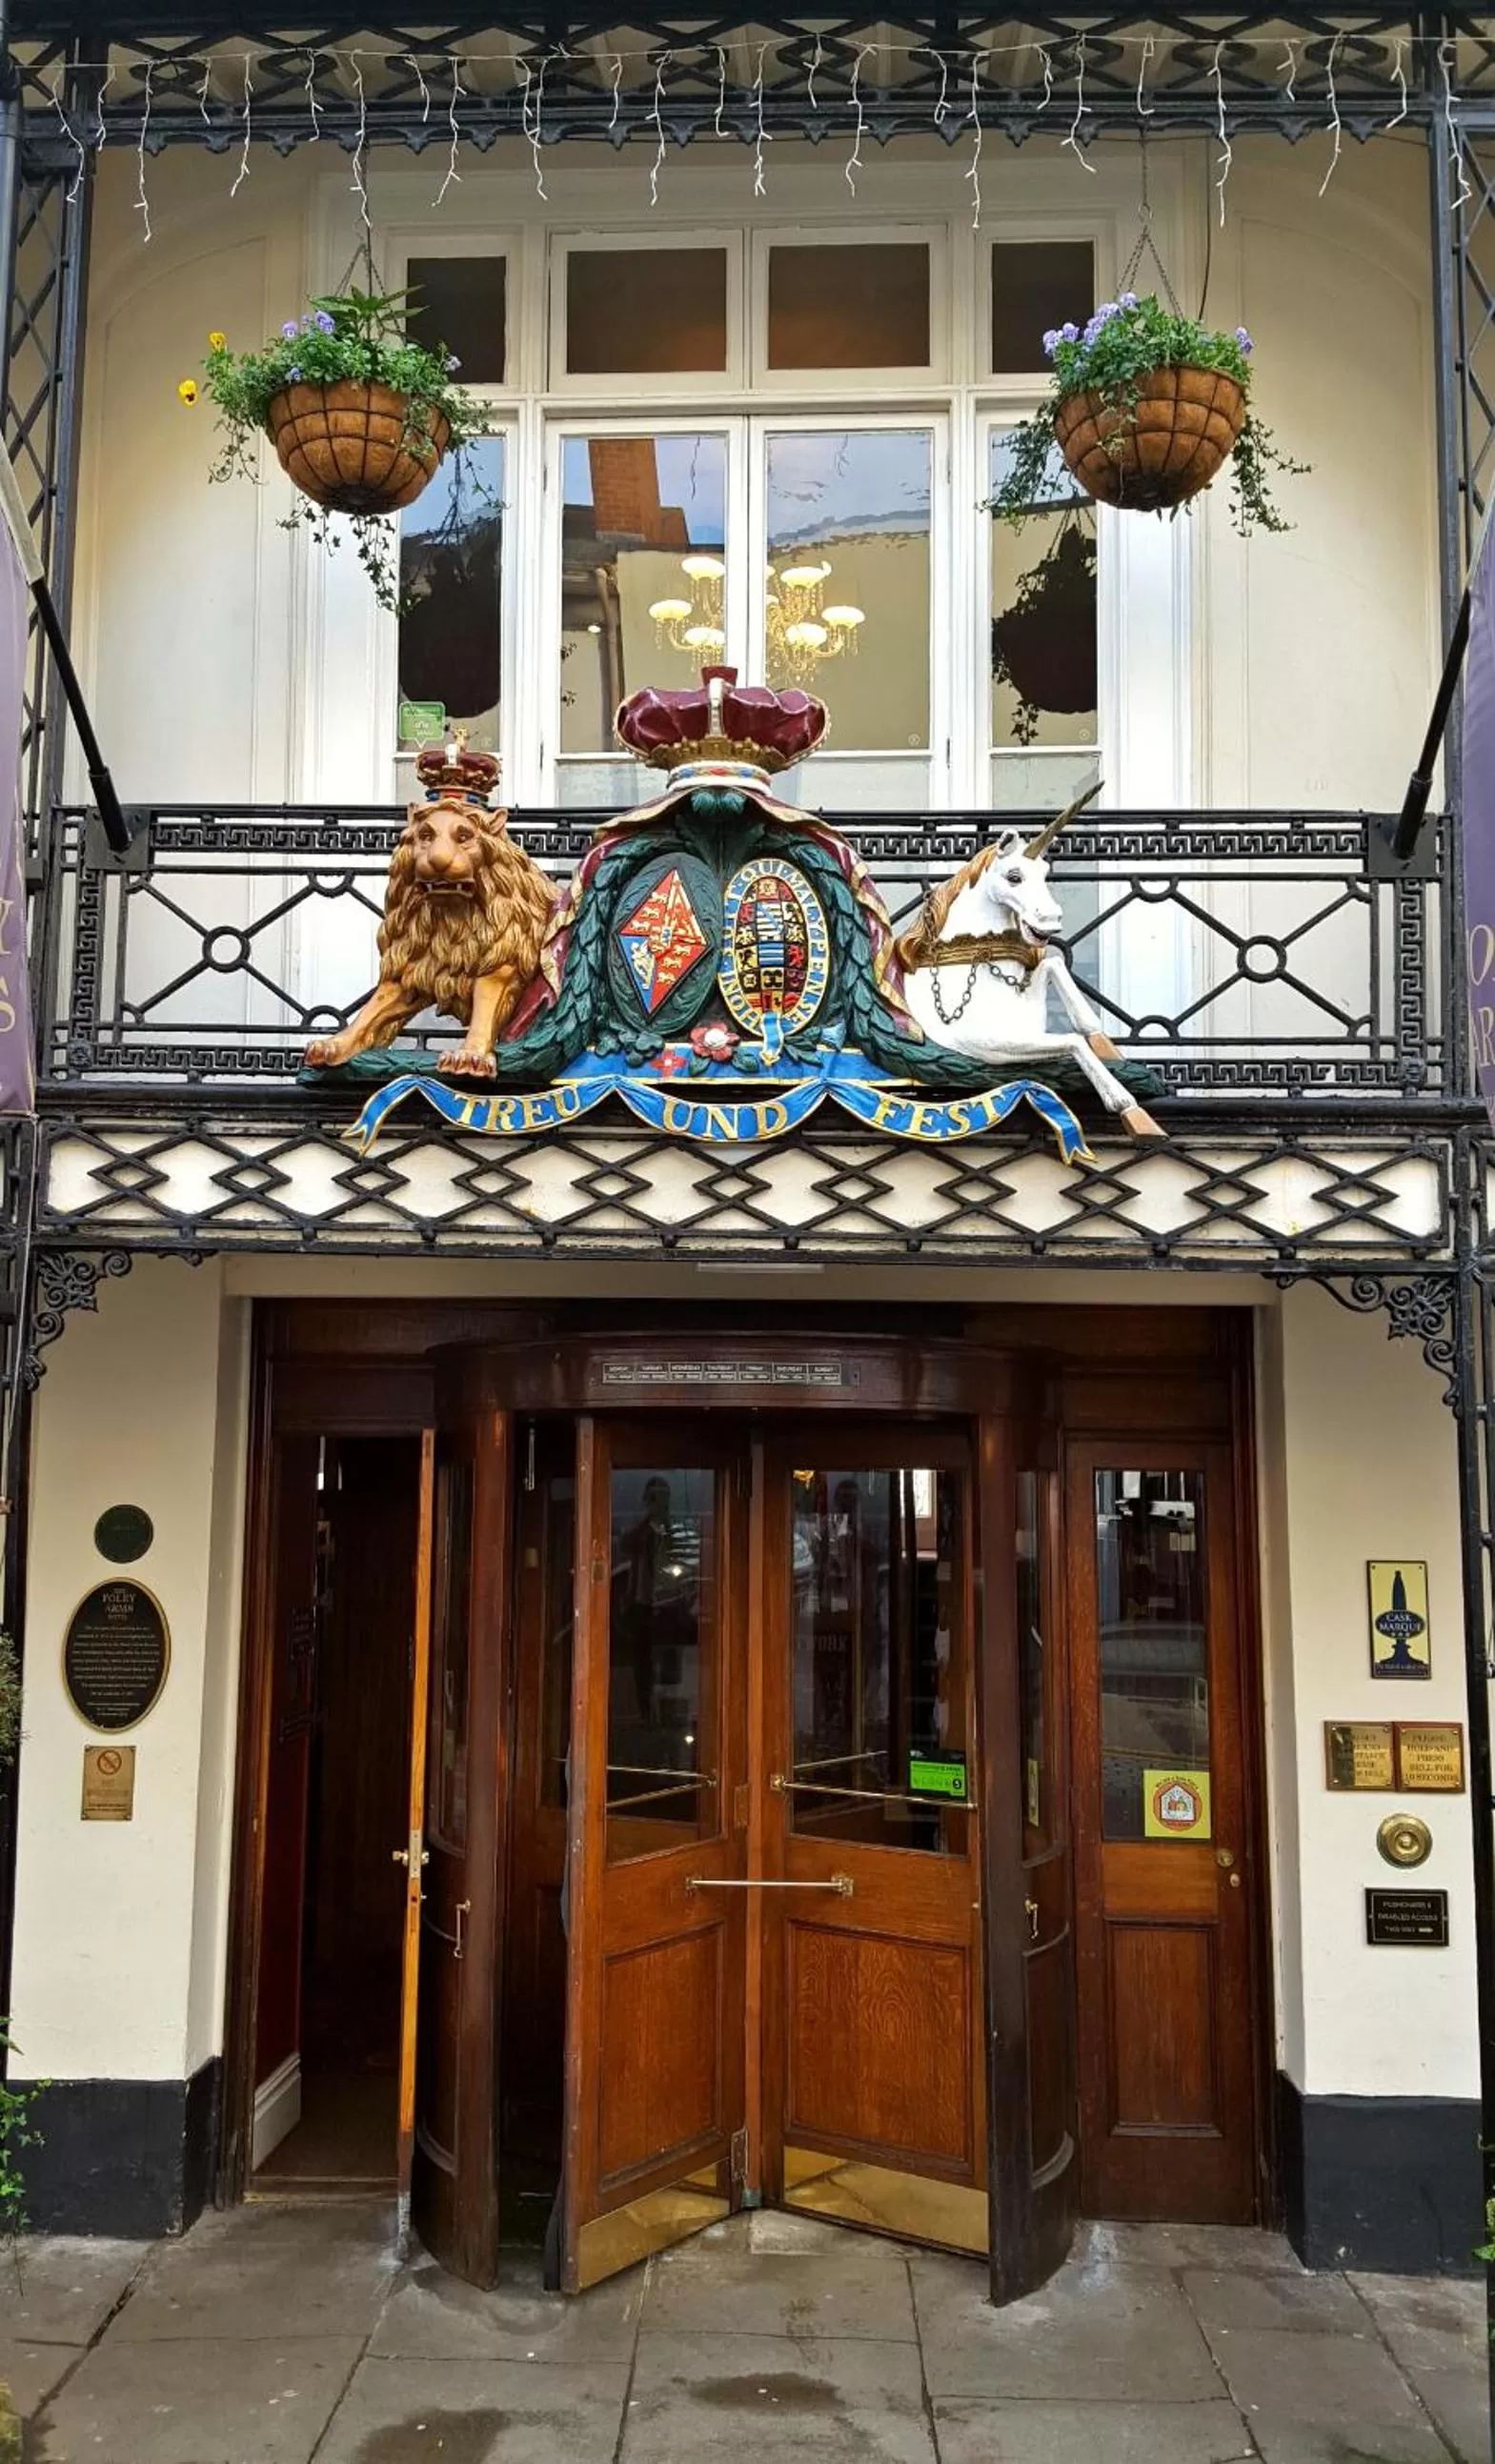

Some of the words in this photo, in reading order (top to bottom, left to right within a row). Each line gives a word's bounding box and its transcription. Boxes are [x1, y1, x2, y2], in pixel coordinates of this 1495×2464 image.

[455, 1083, 583, 1133] TREU
[663, 1101, 789, 1139] UND
[872, 1084, 1007, 1138] FEST
[102, 1593, 136, 1603] FOLEY
[105, 1604, 134, 1613] ARMS
[1385, 1613, 1412, 1623] CASK
